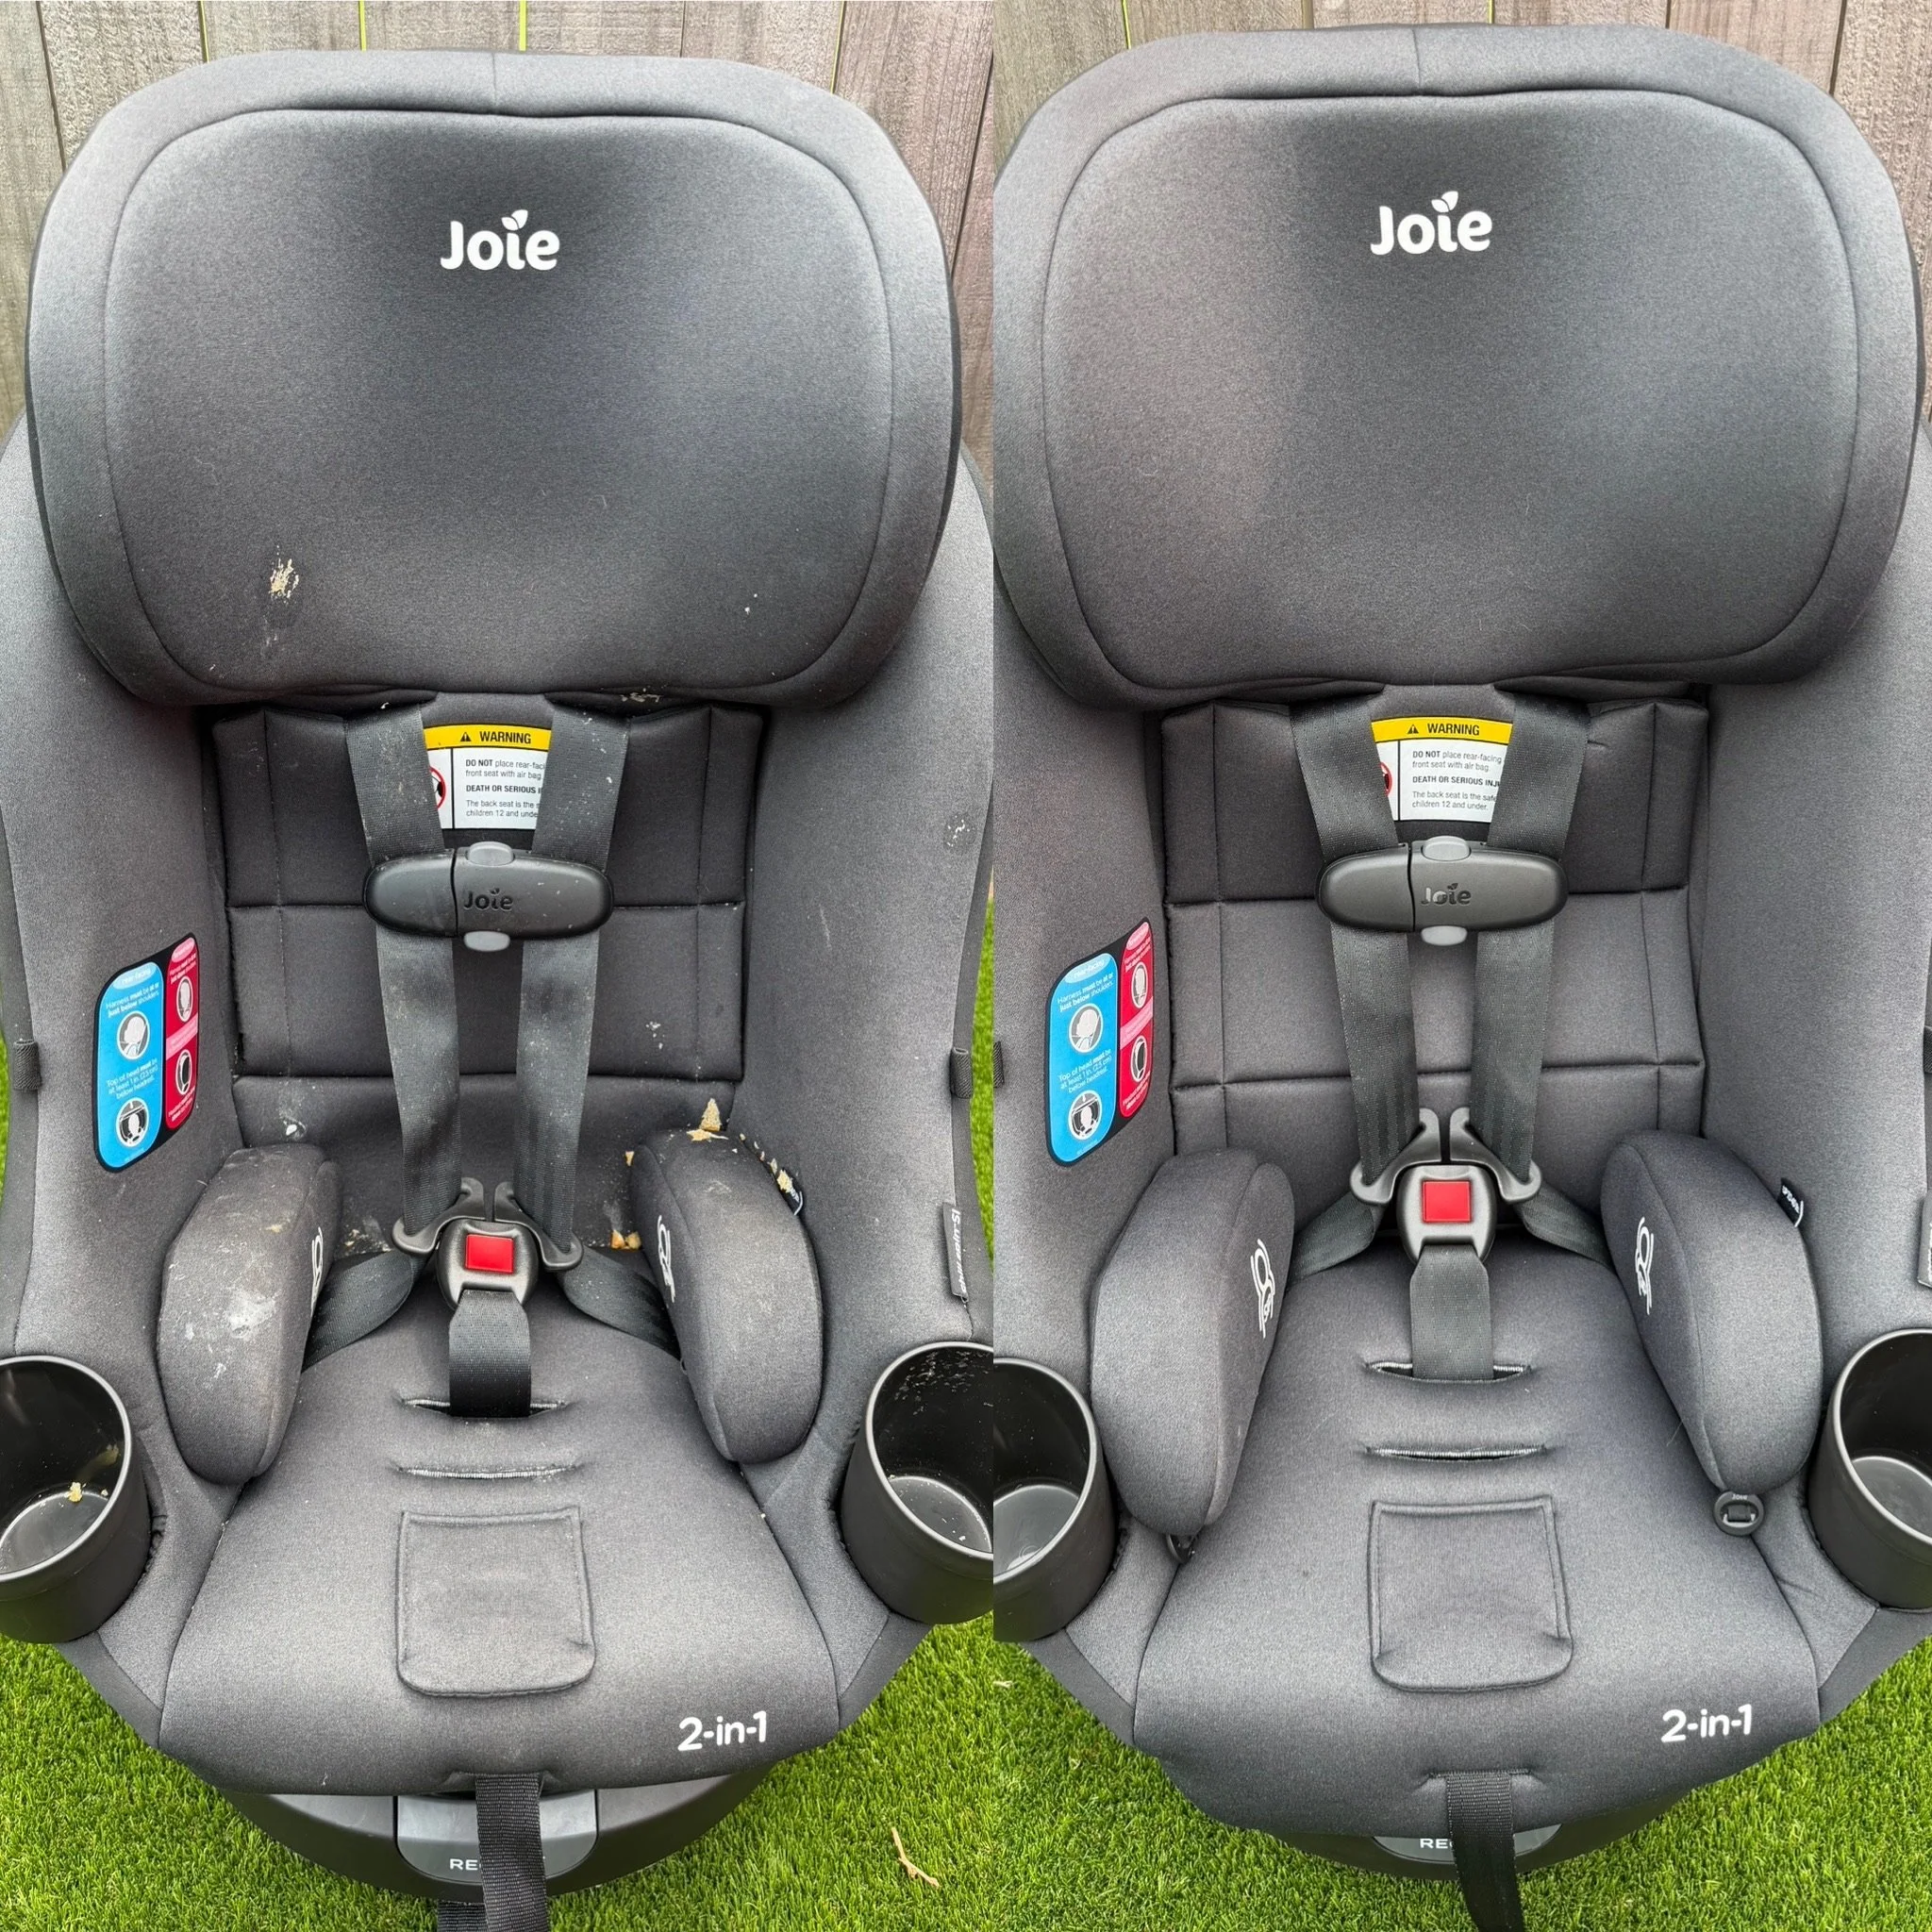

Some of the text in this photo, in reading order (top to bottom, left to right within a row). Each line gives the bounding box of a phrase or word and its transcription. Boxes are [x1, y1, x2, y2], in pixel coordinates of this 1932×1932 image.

[1370, 191, 1492, 255] Joie
[441, 209, 559, 271] Joie
[1427, 723, 1480, 735] WARNING
[479, 731, 531, 744] WARNING
[495, 759, 513, 769] place
[1442, 751, 1461, 760] place
[1463, 754, 1502, 765] rear-facing
[1451, 776, 1483, 785] SERIOUS
[504, 785, 536, 794] SERIOUS
[464, 888, 513, 911] Joie
[1420, 883, 1472, 905] Joie
[1661, 1704, 1752, 1743] 2-in-1
[678, 1710, 767, 1751] 2-in-1
[1420, 1838, 1454, 1849] RE
[450, 1858, 482, 1871] RE
